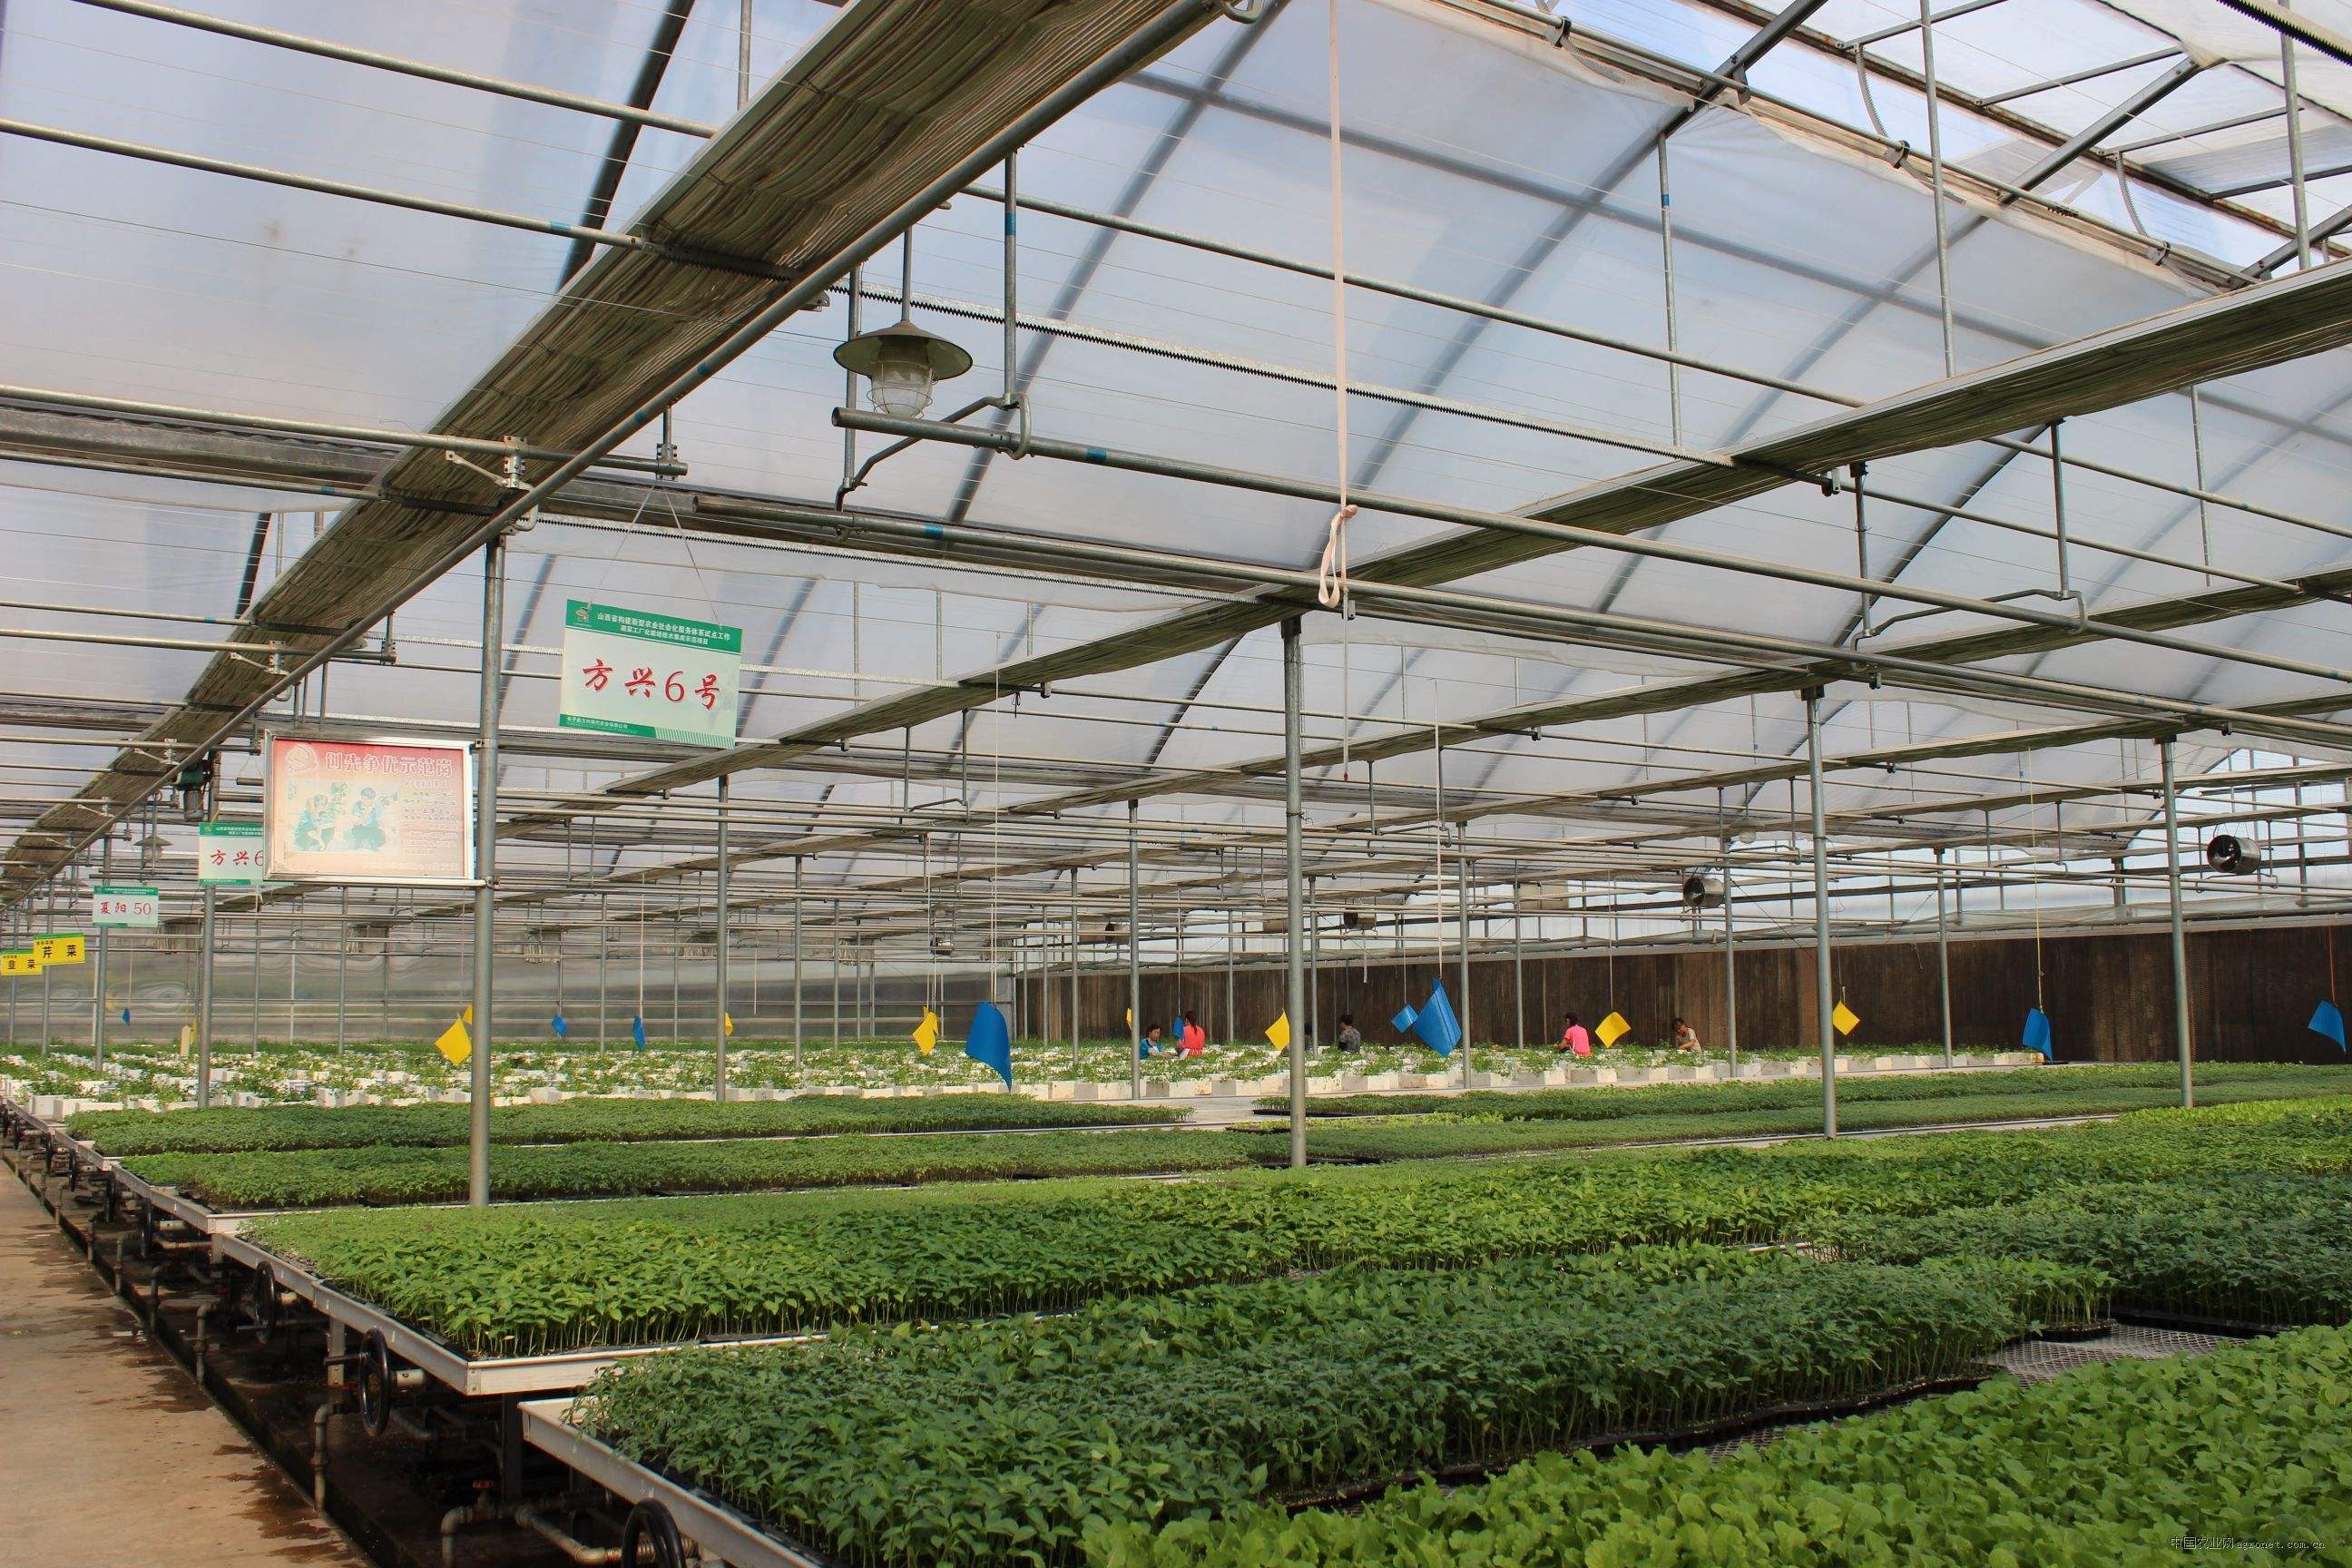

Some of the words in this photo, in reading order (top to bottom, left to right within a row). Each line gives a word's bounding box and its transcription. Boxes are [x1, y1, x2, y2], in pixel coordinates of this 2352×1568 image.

[583, 658, 720, 710] 方兴6号
[325, 751, 453, 777] 创先争优示范岗
[43, 945, 77, 958] 芹菜
[7, 959, 35, 970] 韭菜
